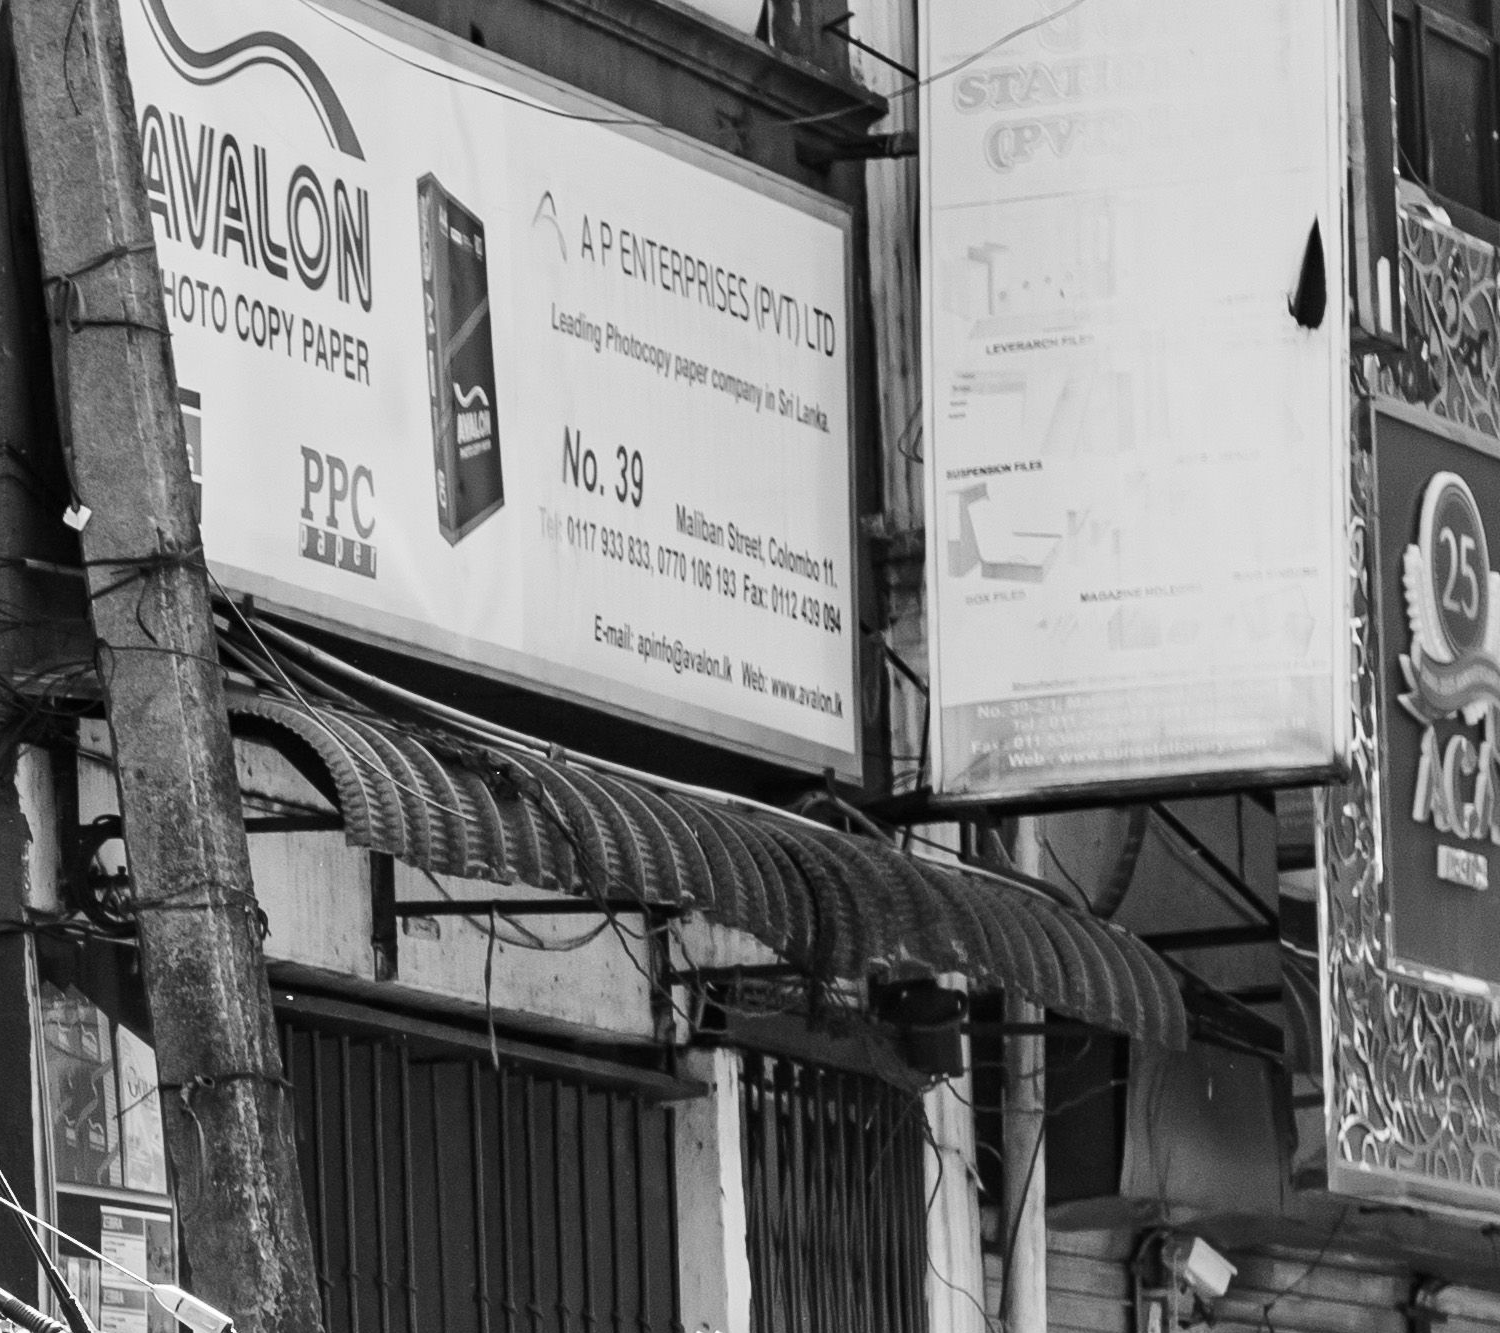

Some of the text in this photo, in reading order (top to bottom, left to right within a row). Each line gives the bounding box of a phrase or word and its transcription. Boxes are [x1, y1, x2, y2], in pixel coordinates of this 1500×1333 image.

[141, 104, 372, 313] AVALON
[161, 268, 371, 387] HOTO COPY PAPER
[582, 213, 836, 357] A P ENTERPRISES (PVT) LTD
[551, 301, 602, 353] Leading
[606, 321, 673, 378] Photocopy
[674, 353, 708, 386] paper
[712, 368, 764, 413] company
[765, 381, 776, 411] in
[778, 388, 793, 419] Sri
[301, 444, 377, 539] PPC
[563, 424, 645, 509] No. 39
[567, 515, 597, 554] 0117
[601, 526, 624, 562] 933
[657, 544, 687, 585] 0770
[691, 556, 713, 593] 106
[717, 565, 737, 600] 193
[771, 583, 798, 621] 0112
[800, 593, 821, 630] 439
[675, 503, 725, 549] Maliban
[768, 536, 821, 583] Colombo
[1439, 525, 1480, 620] 25
